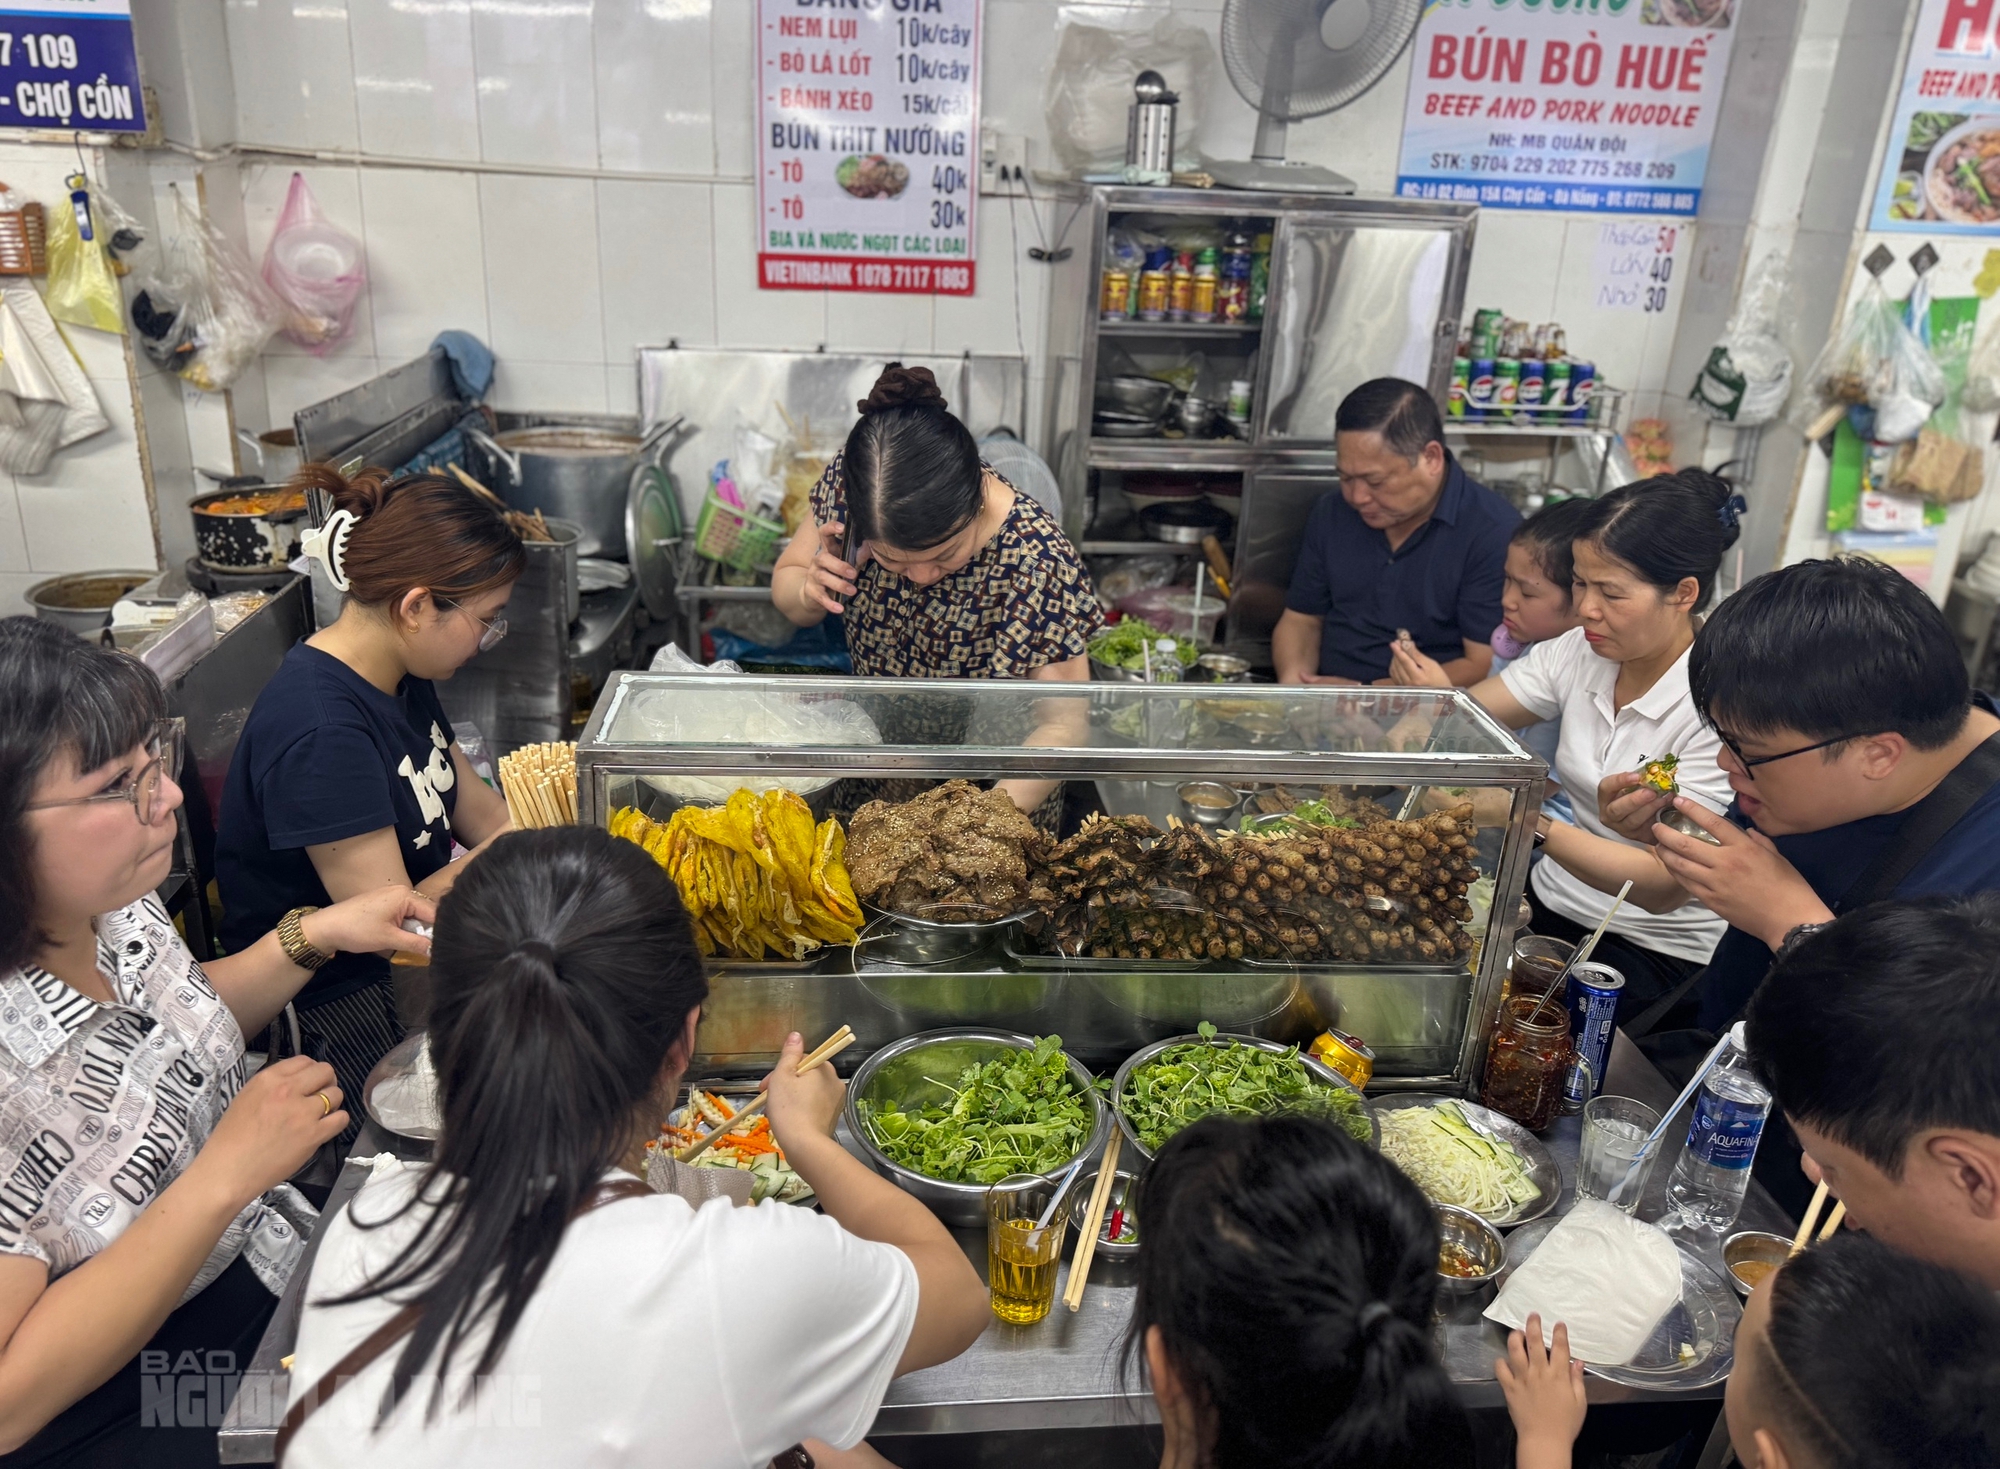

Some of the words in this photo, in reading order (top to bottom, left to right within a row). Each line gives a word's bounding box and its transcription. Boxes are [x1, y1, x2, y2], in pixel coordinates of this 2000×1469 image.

[780, 17, 823, 38] NEM
[21, 33, 78, 70] 109
[811, 50, 833, 75] LÁ
[1427, 26, 1527, 83] BÚN
[1540, 31, 1604, 88] BÒ
[1616, 33, 1717, 92] HUẾ
[1918, 69, 1957, 96] BEEF
[1955, 72, 1987, 98] AND
[16, 80, 73, 125] CHỢ
[77, 72, 134, 120] CỒN
[1424, 93, 1484, 116] BEEF
[1487, 97, 1537, 120] AND
[1542, 100, 1605, 123] PORK
[1610, 103, 1701, 128] NOODLE
[772, 117, 820, 151] BÚN
[884, 123, 966, 157] NƯỚNG
[1520, 134, 1547, 149] MB
[781, 157, 804, 183] TÔ
[931, 165, 967, 194] 40k
[1513, 157, 1544, 174] 229
[1548, 158, 1577, 176] 202
[1580, 159, 1610, 177] 775
[782, 195, 804, 220] TÔ
[930, 201, 966, 229] 30k
[769, 230, 793, 247] BIA
[1655, 225, 1677, 254] 50
[764, 260, 853, 285] VIETINBANK
[893, 266, 931, 289] 7117
[1650, 256, 1673, 283] 40
[1644, 286, 1667, 312] 30
